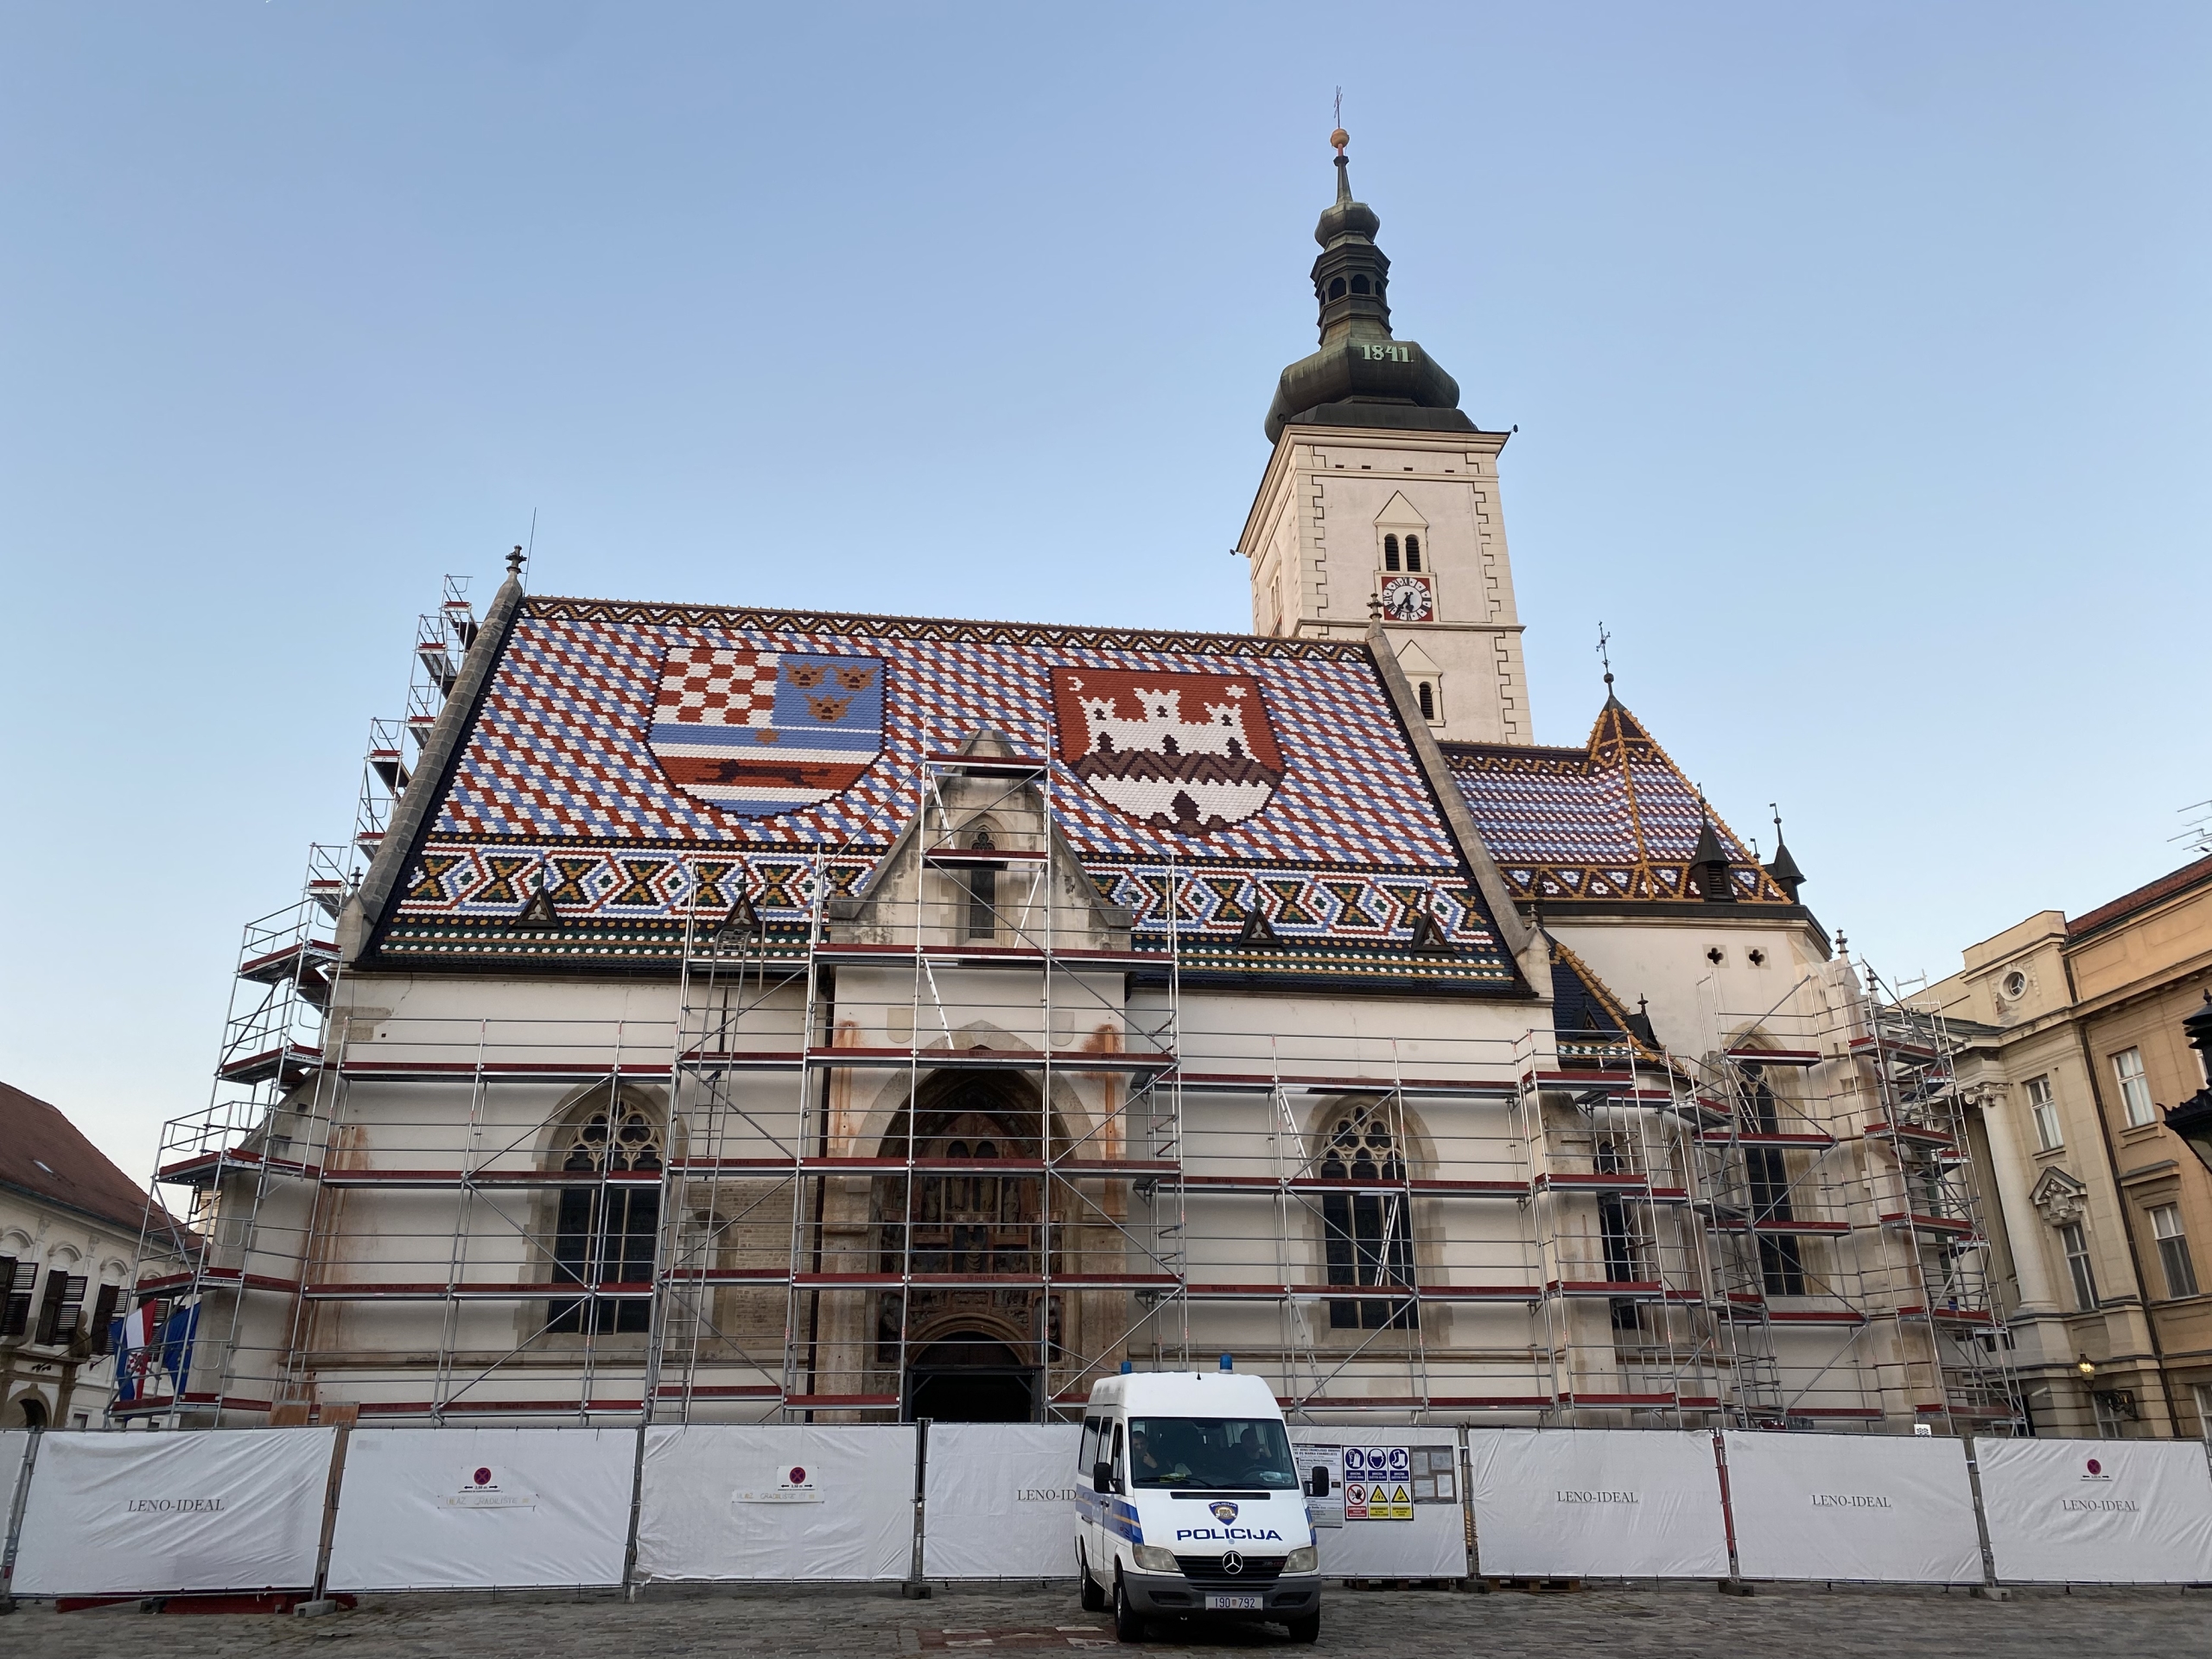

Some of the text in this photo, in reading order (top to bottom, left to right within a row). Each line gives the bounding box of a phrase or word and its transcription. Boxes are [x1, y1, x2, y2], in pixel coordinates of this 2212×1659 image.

[1556, 1491, 1638, 1503] LENO-IDEAL
[1811, 1494, 1892, 1508] LENO-IDEAL
[127, 1498, 225, 1512] LENO-IDEAL
[2062, 1499, 2140, 1511] LENO-IDEAL
[1176, 1529, 1283, 1541] POLICIJA
[1215, 1598, 1255, 1608] 190 792
